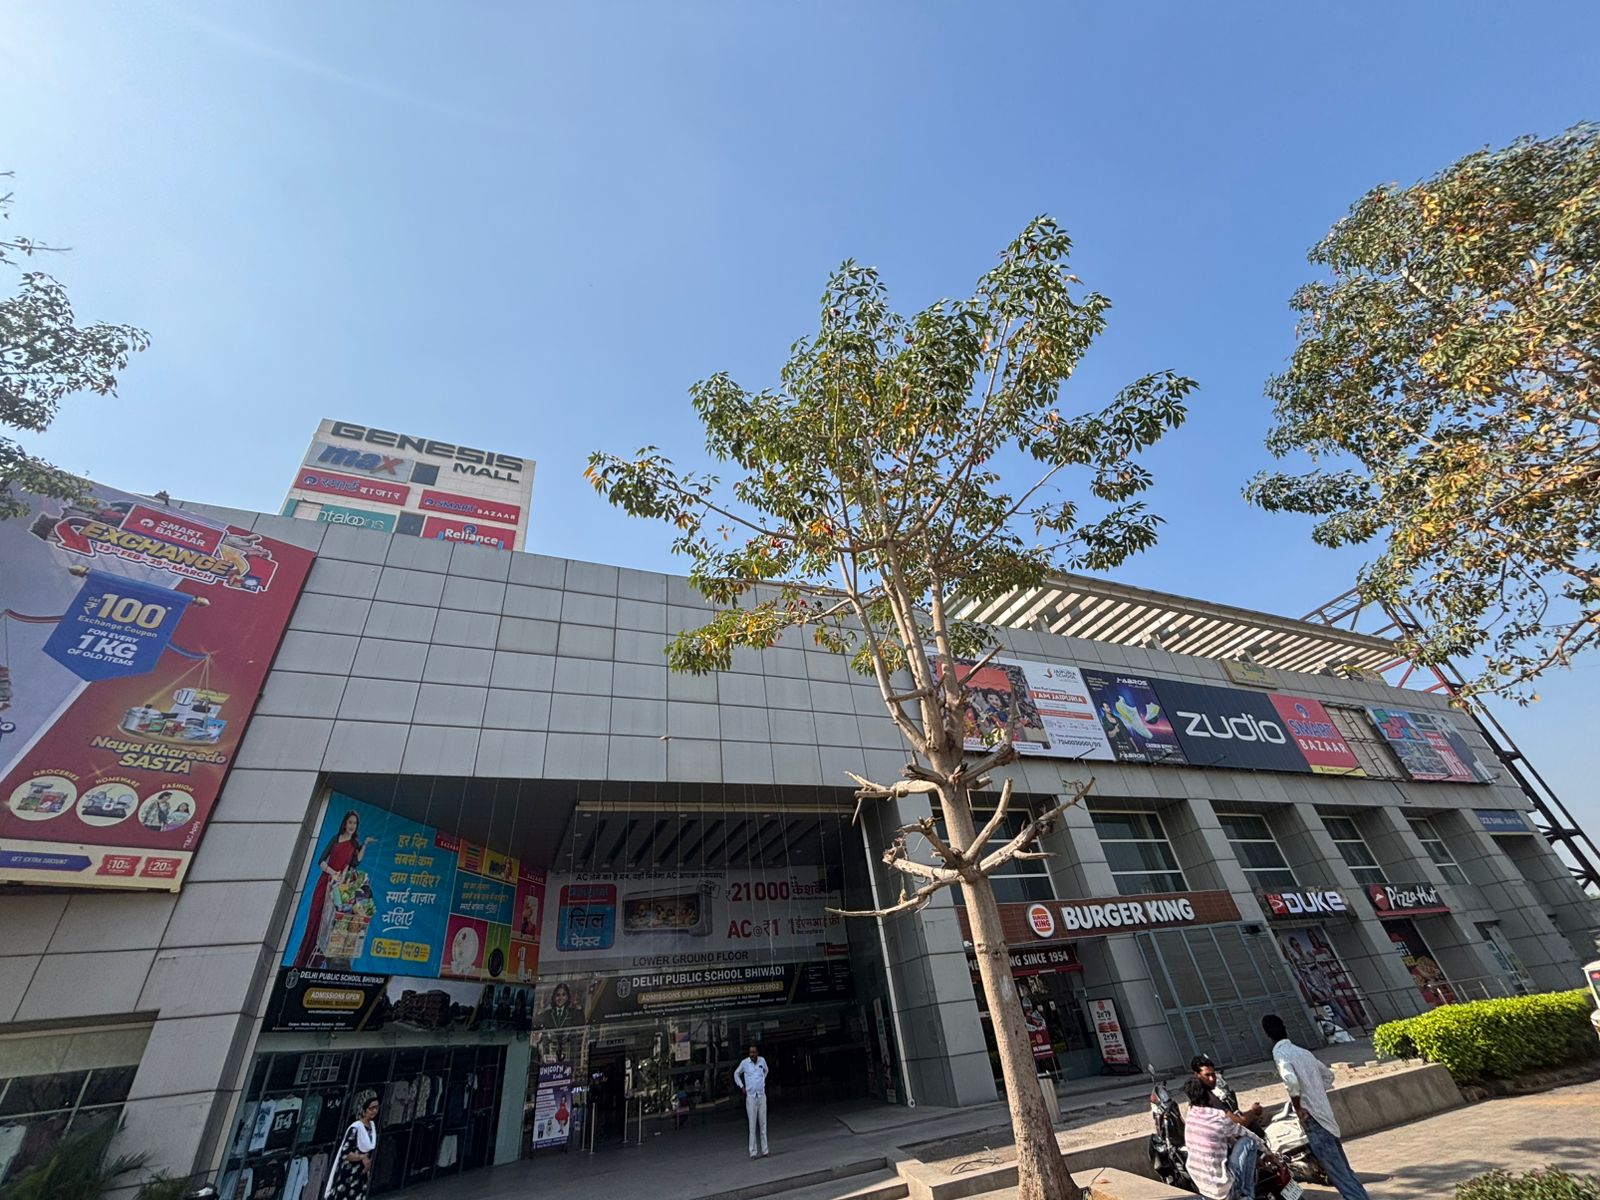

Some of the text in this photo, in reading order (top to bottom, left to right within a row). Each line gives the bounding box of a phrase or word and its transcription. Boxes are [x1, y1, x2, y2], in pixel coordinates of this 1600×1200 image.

[331, 421, 524, 471] GENESIS
[318, 445, 403, 475] max
[453, 463, 520, 483] MALL
[320, 510, 384, 529] ntaloons
[477, 508, 516, 520] BAZAAR
[154, 526, 206, 547] BAZAAR
[160, 520, 204, 538] SMART
[445, 527, 498, 546] Reliance
[81, 522, 237, 576] EXCHANGE
[120, 550, 141, 561] FEB
[172, 564, 213, 580] MARCH
[78, 615, 158, 638] Exchange Coupon
[87, 628, 139, 643] FOR EVERY
[67, 648, 135, 666] OF OLD ITEMS
[1052, 694, 1083, 703] JAIPURIA
[1288, 718, 1337, 739] SMART
[90, 735, 228, 766] Naya Khareedo
[1298, 738, 1349, 755] BAZAAR
[118, 753, 192, 776] SASTA
[32, 768, 80, 782] GROCERIES
[95, 776, 141, 788] HOMEWARE
[161, 783, 194, 793] FASHION
[576, 873, 588, 881] AC
[666, 871, 677, 879] AC
[385, 887, 411, 904] स्मार्ट
[1281, 891, 1347, 914] DUKE
[1385, 885, 1438, 910] Pizza Hut
[382, 906, 415, 926] चलिए
[569, 907, 605, 929] चिल
[1060, 898, 1195, 930] BURGER KING
[1033, 919, 1051, 928] KING
[571, 934, 601, 947] फेस्ट
[632, 951, 749, 967] LOWER GROUND FLOOR
[1022, 953, 1047, 966] SINCE
[1048, 950, 1069, 962] 1954
[300, 971, 319, 979] DELHI
[319, 972, 340, 981] PUBLIC
[340, 974, 361, 982] SCHOOL
[632, 975, 663, 987] DELHI
[665, 972, 702, 985] PUBLIC
[704, 968, 743, 981] SCHOOL
[745, 966, 785, 978] BHIWADI
[311, 991, 360, 1000] ADMISSIONS OPEN
[641, 992, 681, 1001] ADMISSIONS
[682, 990, 698, 998] OPEN
